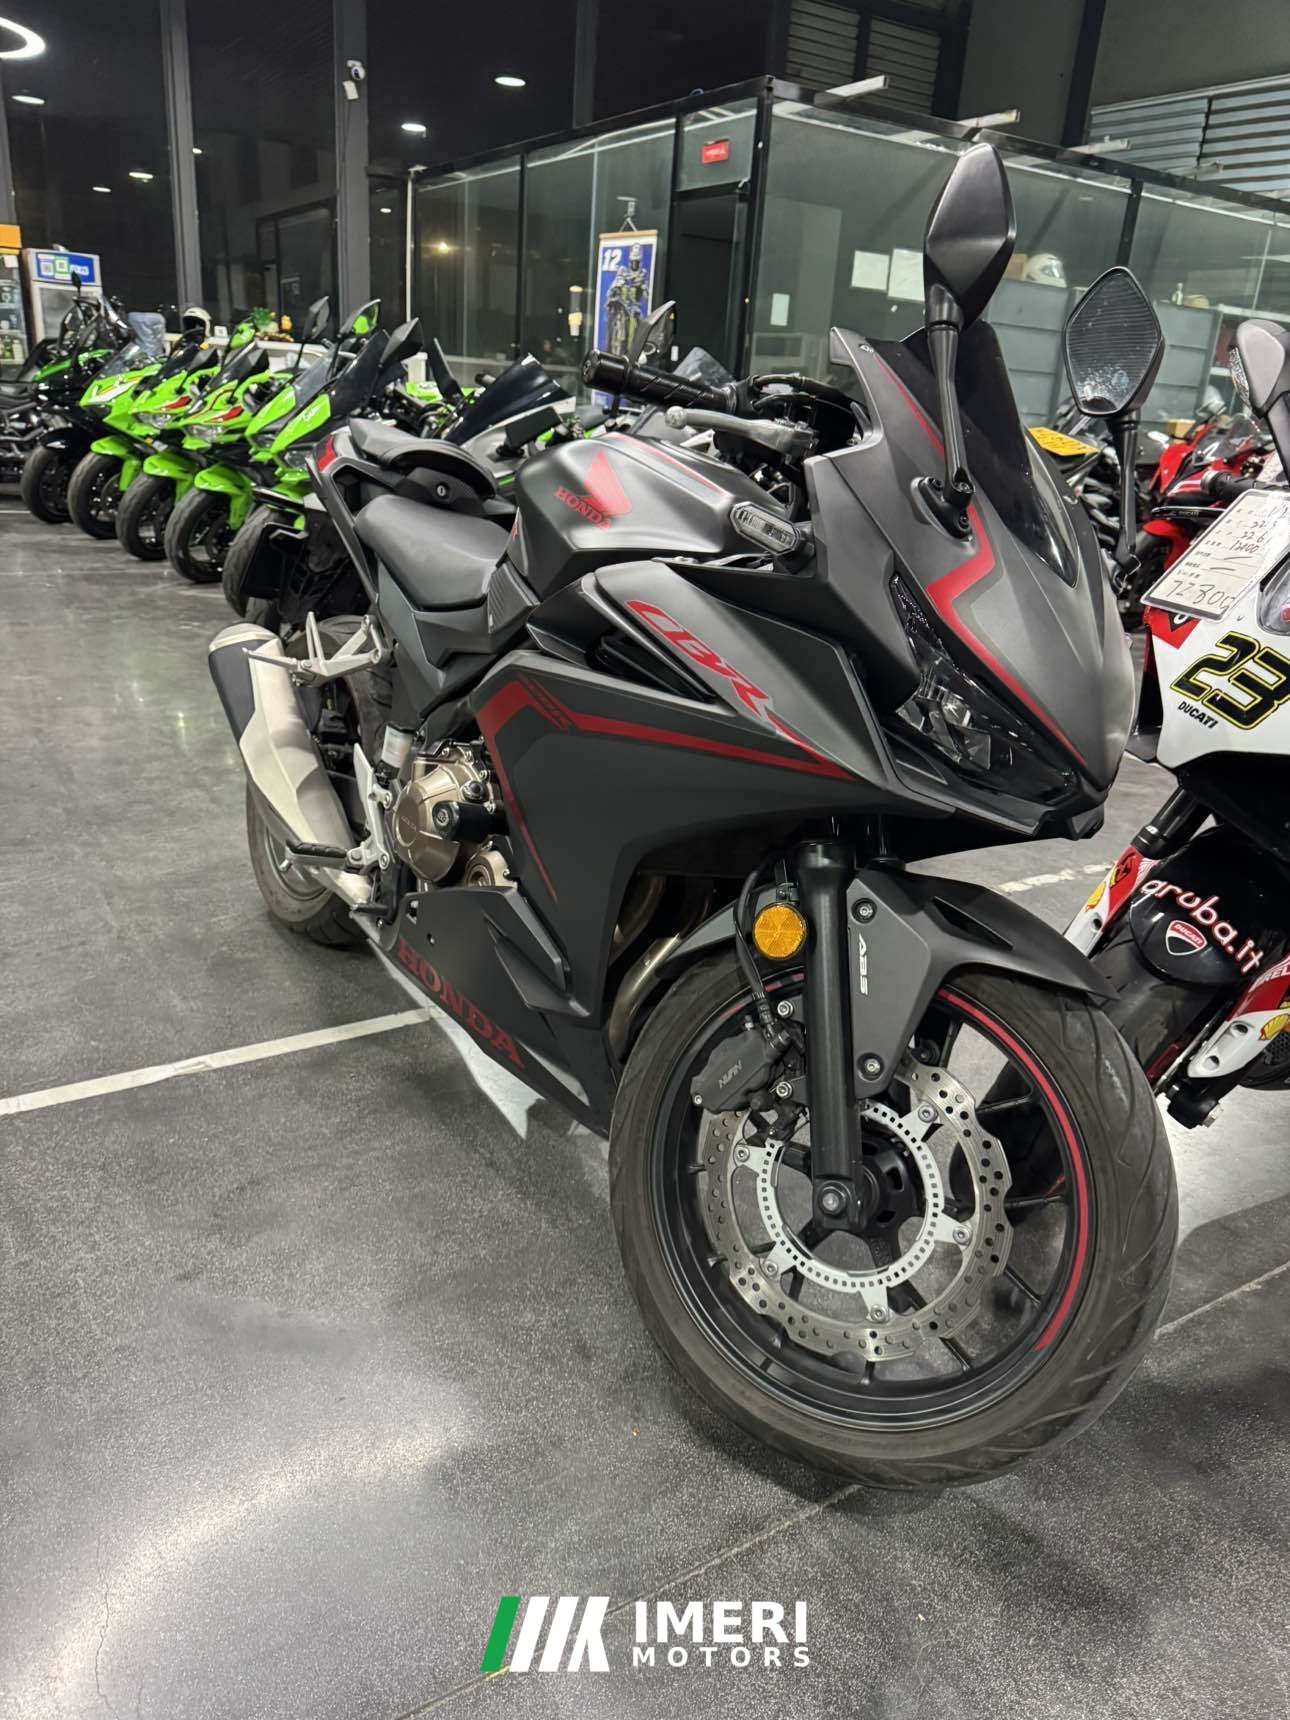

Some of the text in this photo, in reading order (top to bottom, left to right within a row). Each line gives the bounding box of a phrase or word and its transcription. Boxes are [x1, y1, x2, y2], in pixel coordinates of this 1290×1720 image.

[603, 248, 623, 272] 12
[554, 486, 612, 532] HONDA
[624, 600, 769, 717] CBR
[1169, 630, 1290, 731] 23
[1178, 701, 1219, 729] DUCATI
[1140, 880, 1264, 974] aruba.it
[1173, 923, 1203, 945] DUCATI
[858, 933, 869, 996] ABS
[398, 935, 525, 1069] HONDA
